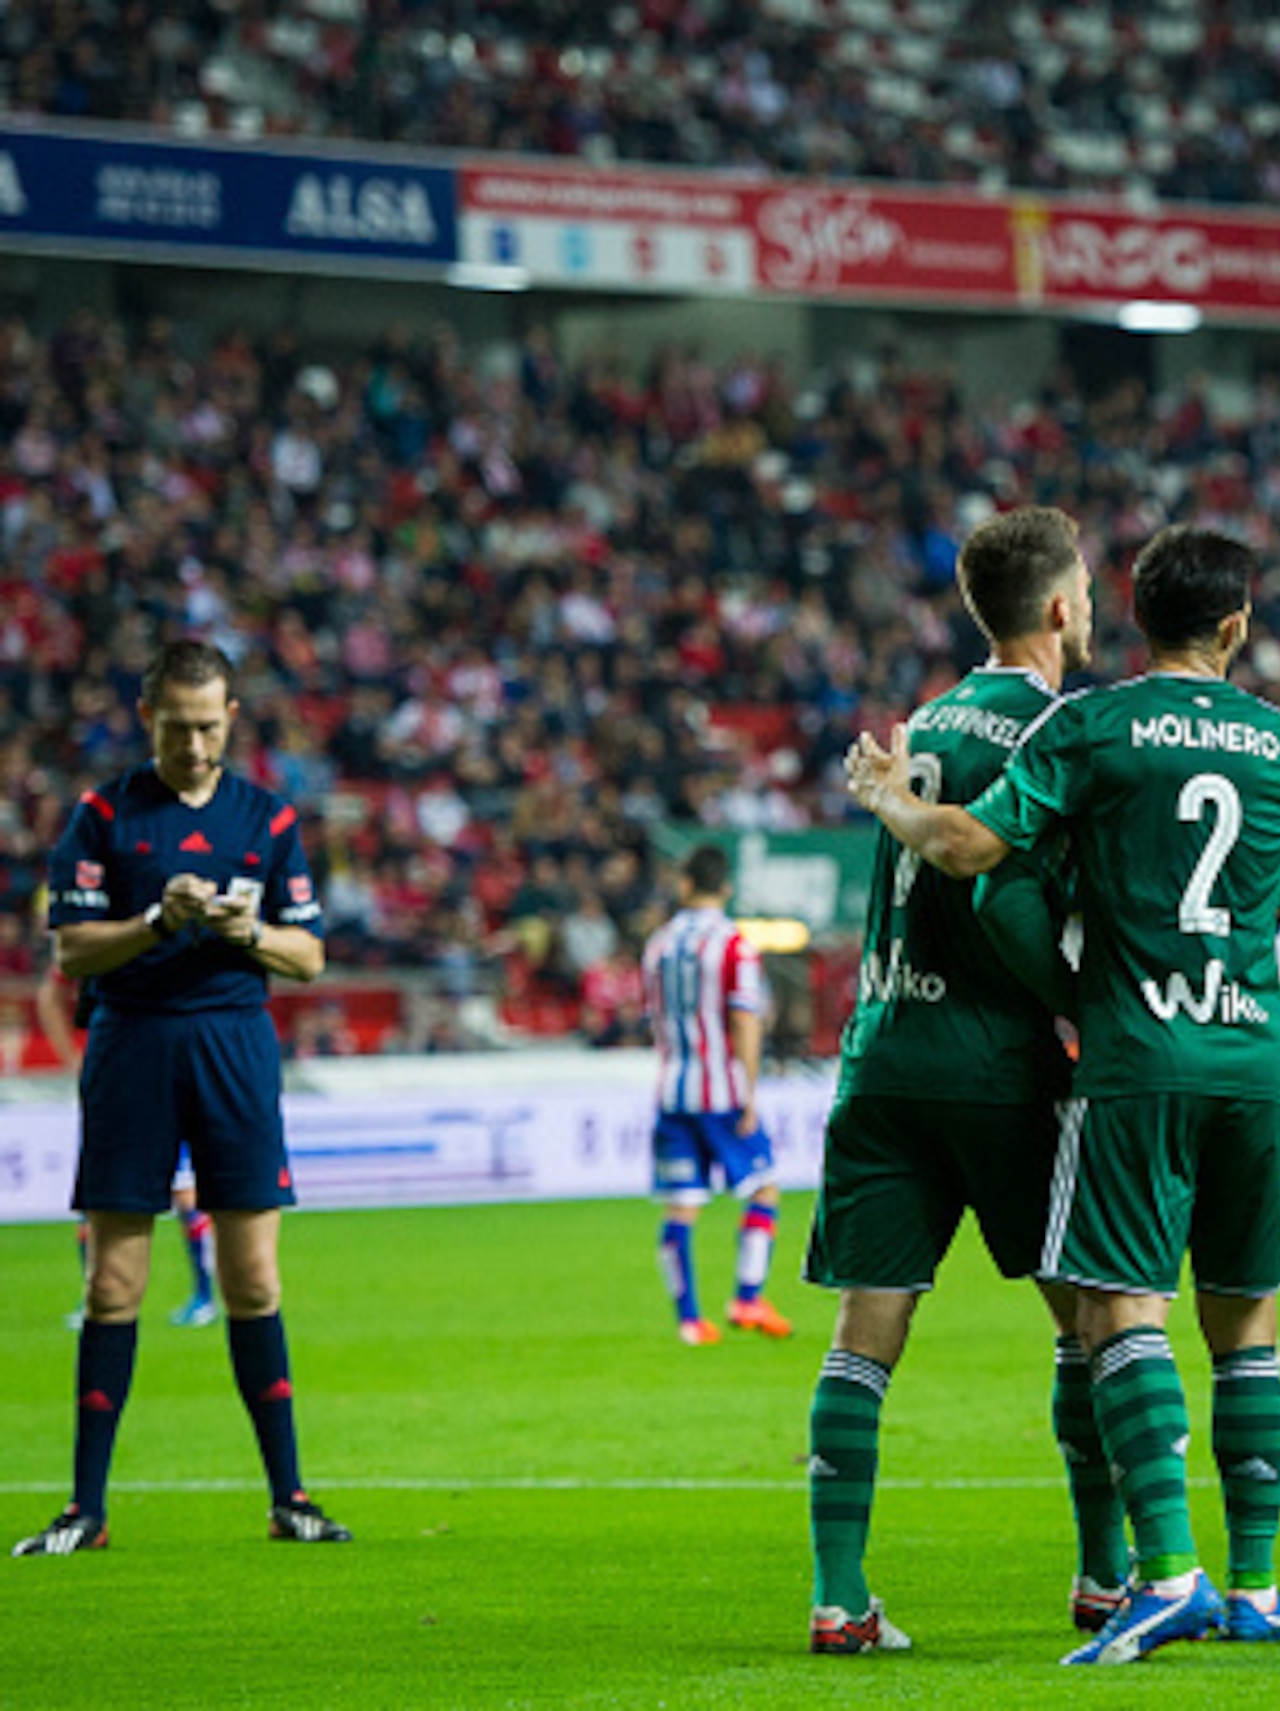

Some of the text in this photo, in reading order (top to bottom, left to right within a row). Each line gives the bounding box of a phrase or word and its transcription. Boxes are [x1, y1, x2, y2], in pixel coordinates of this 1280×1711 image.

[286, 172, 438, 246] ALSA
[1177, 772, 1243, 939] 2
[860, 936, 947, 1004] Wiko
